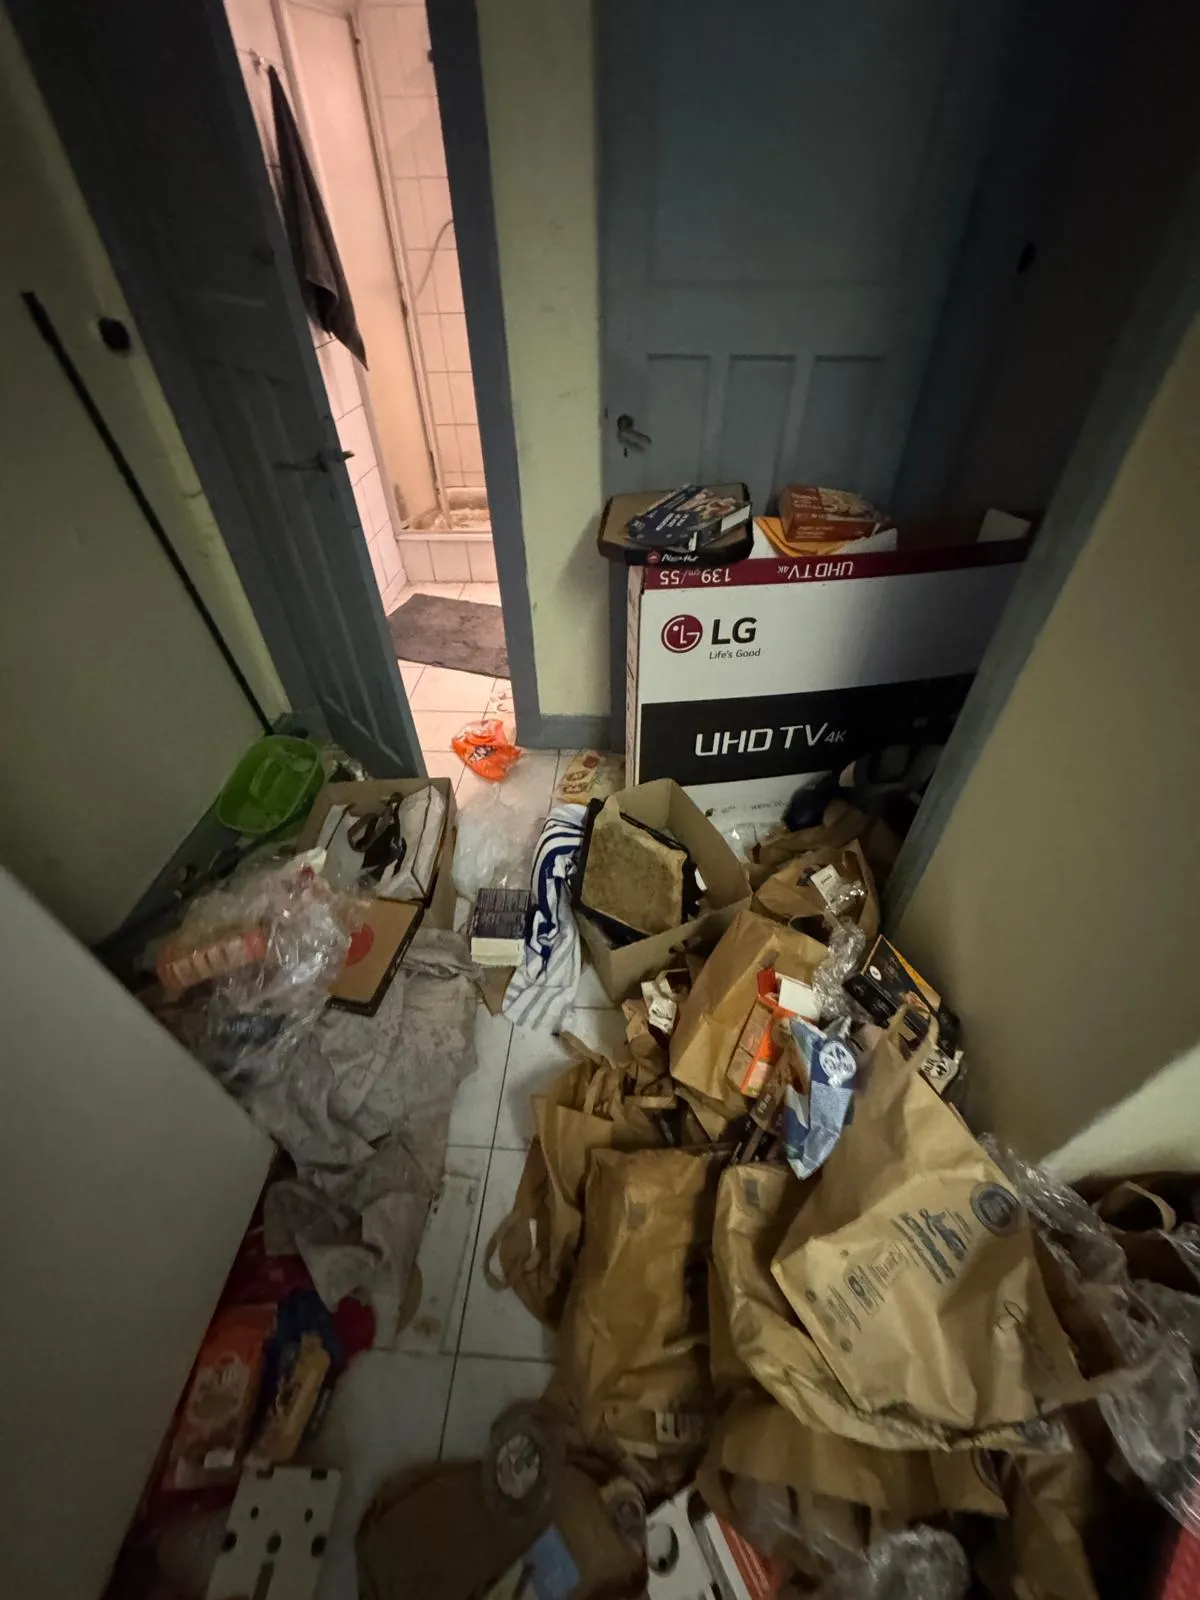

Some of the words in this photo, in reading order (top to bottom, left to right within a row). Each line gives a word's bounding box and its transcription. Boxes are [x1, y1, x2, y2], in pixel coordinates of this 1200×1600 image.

[711, 617, 757, 645] LG
[709, 649, 733, 660] Life's
[735, 647, 761, 658] Good
[695, 728, 773, 757] UHD
